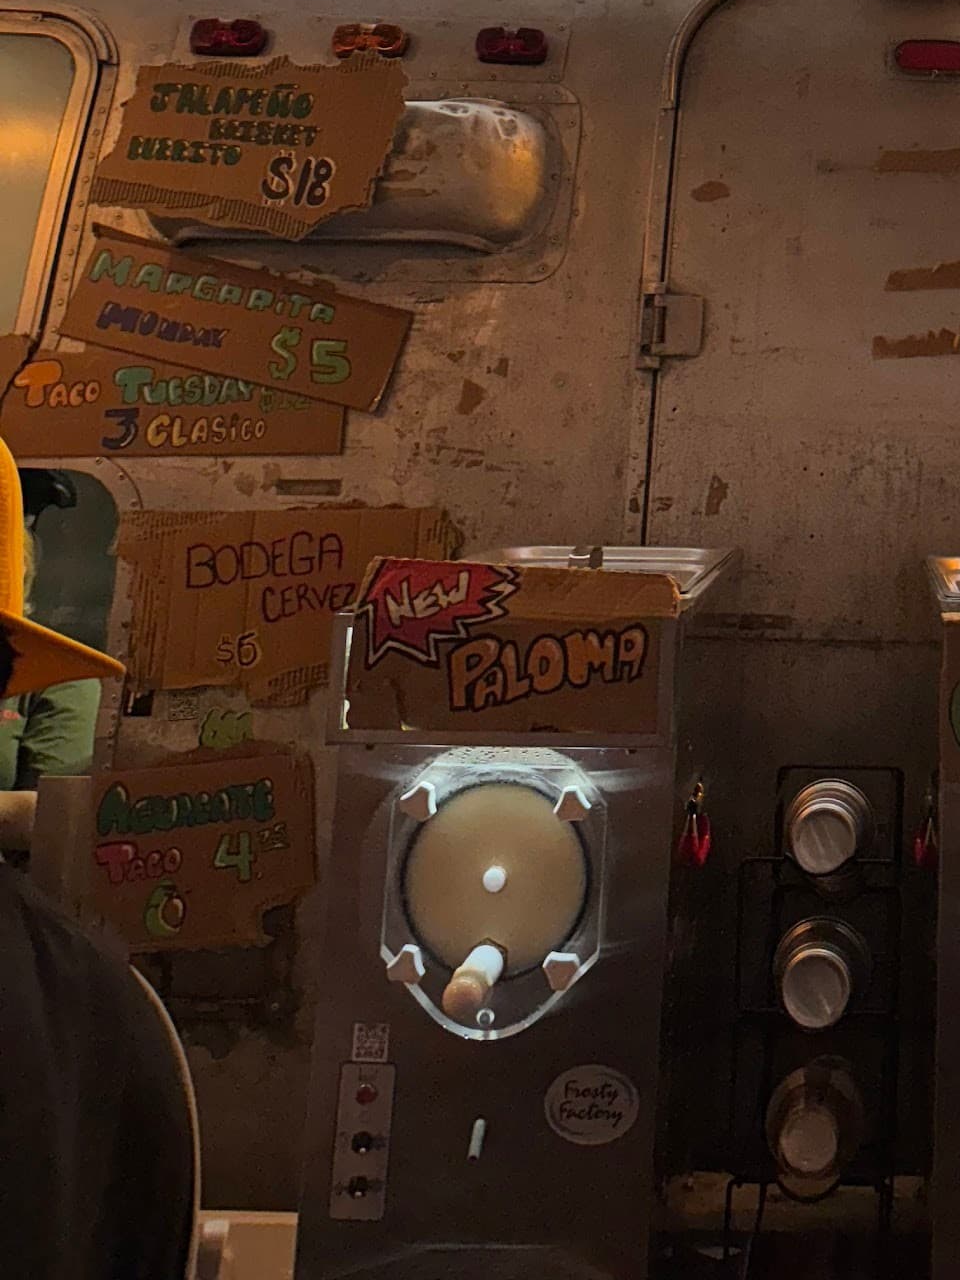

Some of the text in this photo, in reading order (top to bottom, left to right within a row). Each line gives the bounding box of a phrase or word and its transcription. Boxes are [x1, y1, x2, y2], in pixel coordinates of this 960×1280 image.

[150, 83, 315, 119] JALAPEÑO
[261, 149, 338, 208] $18
[267, 325, 352, 384] $5
[114, 365, 255, 407] TUESDAY
[102, 407, 140, 450] 3
[185, 530, 343, 590] BODEGA
[261, 581, 357, 623] CERVEZ
[449, 622, 647, 712] PALOMA
[564, 1079, 620, 1102] Frosty
[557, 1097, 624, 1128] Factory
